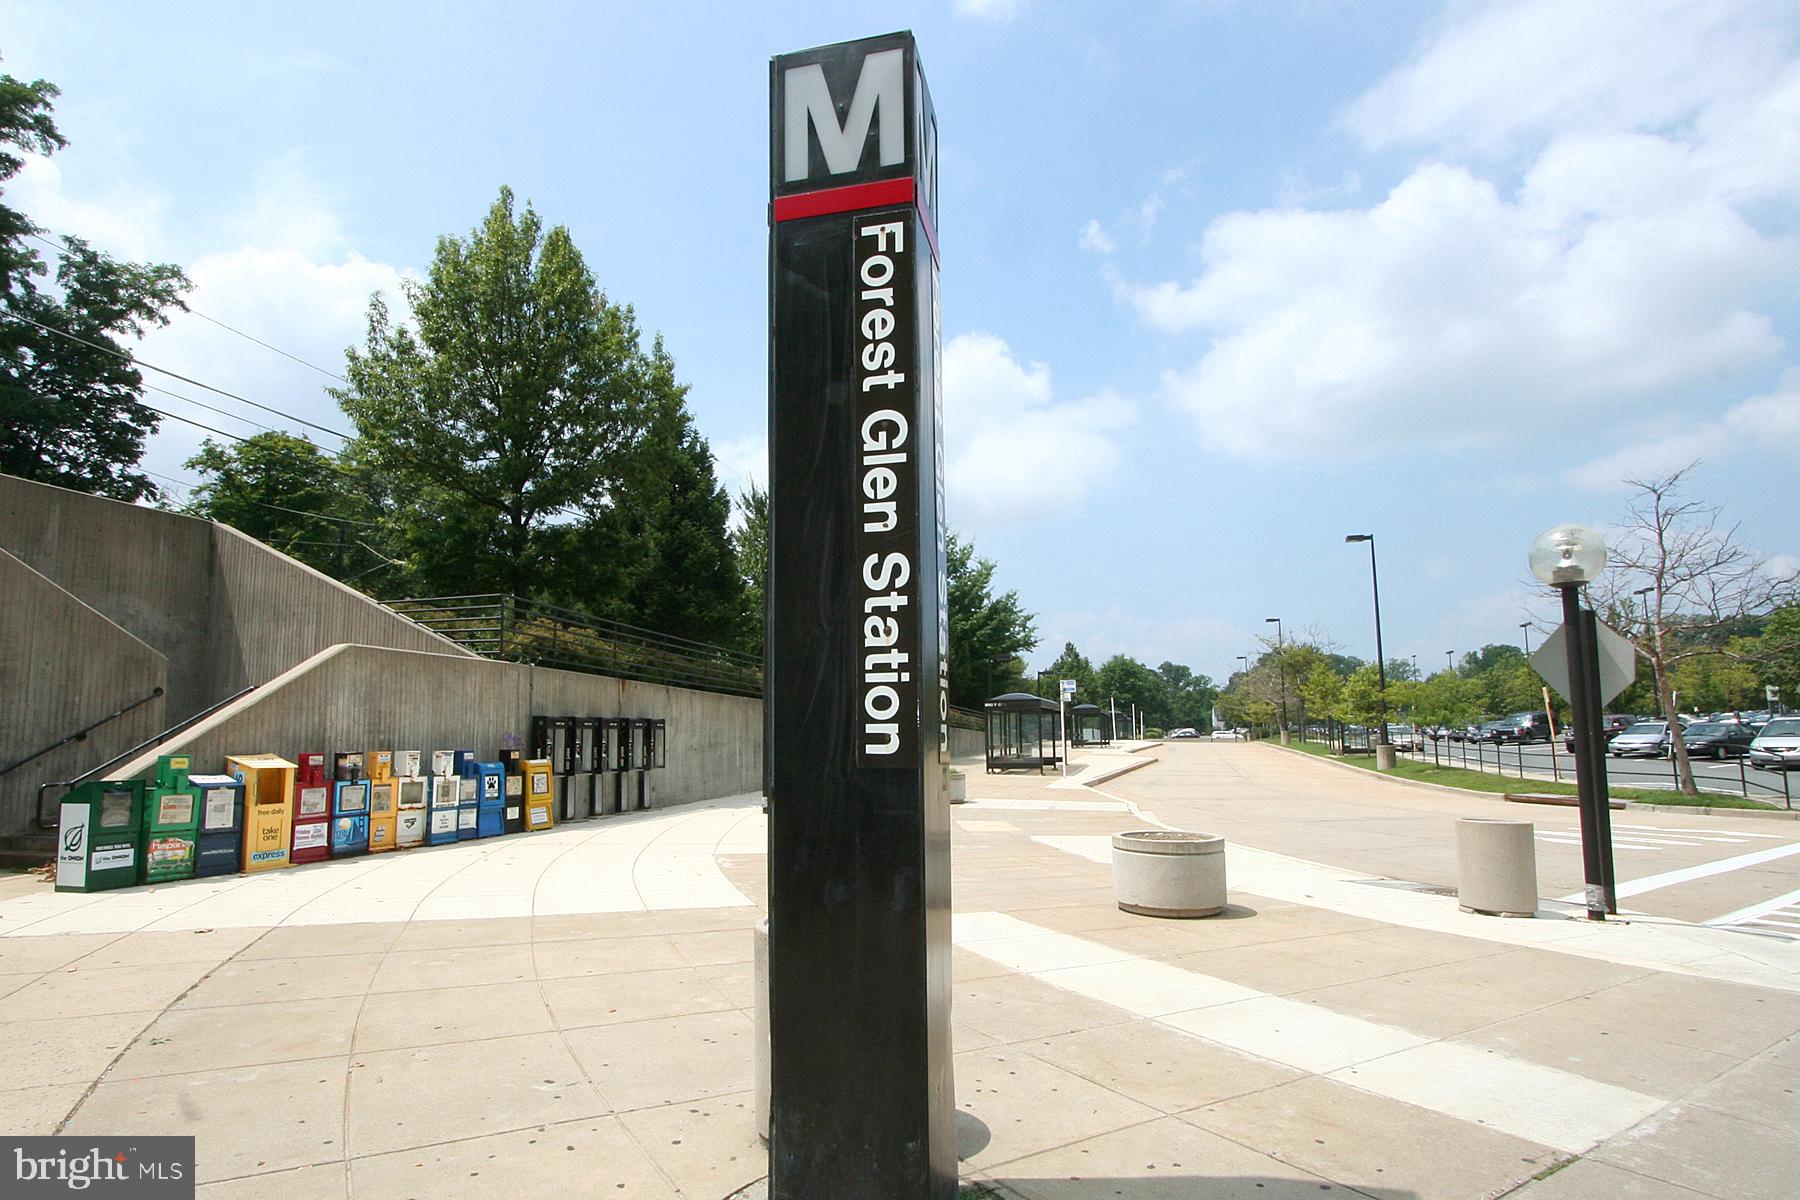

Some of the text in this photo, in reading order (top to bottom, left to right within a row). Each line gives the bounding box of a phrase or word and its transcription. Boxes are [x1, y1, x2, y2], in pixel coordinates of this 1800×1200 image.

[785, 48, 905, 182] M
[861, 221, 911, 755] Forest Glen Station
[935, 443, 945, 553] Glen
[938, 570, 949, 753] Station
[262, 826, 280, 835] take
[262, 834, 278, 842] one
[271, 808, 285, 816] daily
[252, 850, 286, 861] express
